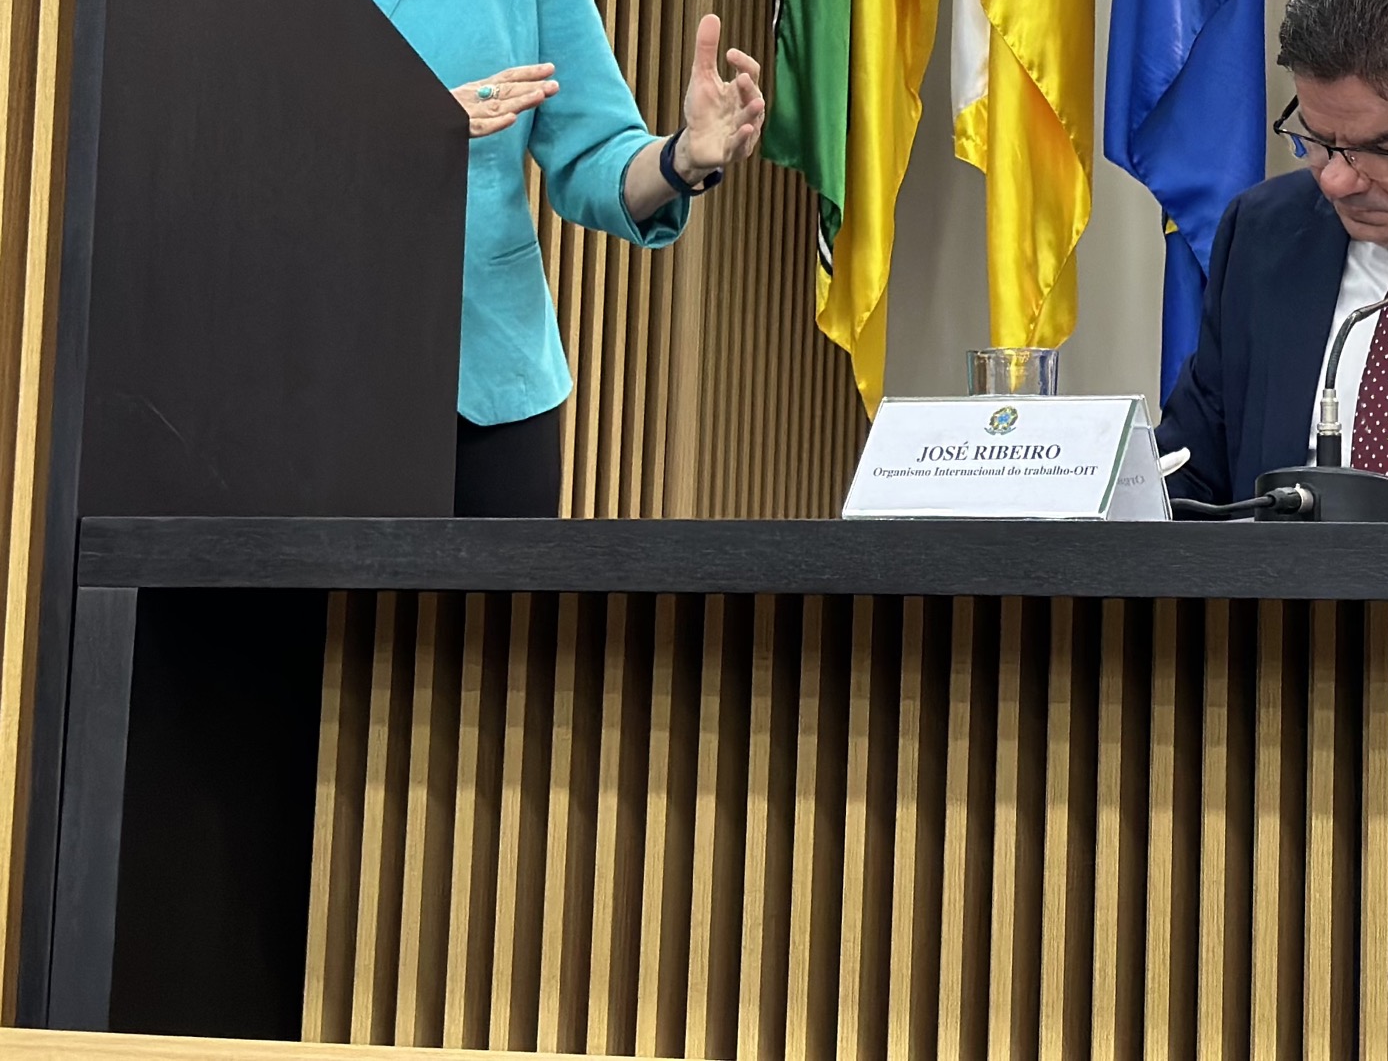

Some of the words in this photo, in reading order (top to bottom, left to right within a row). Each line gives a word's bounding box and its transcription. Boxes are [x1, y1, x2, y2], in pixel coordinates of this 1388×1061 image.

[916, 441, 969, 463] JOSÉ
[972, 443, 1061, 461] RIBEIRO
[873, 466, 932, 479] Organismo
[934, 465, 1006, 477] Internacional
[1007, 465, 1022, 476] do
[1023, 465, 1099, 477] trabalho-OIT
